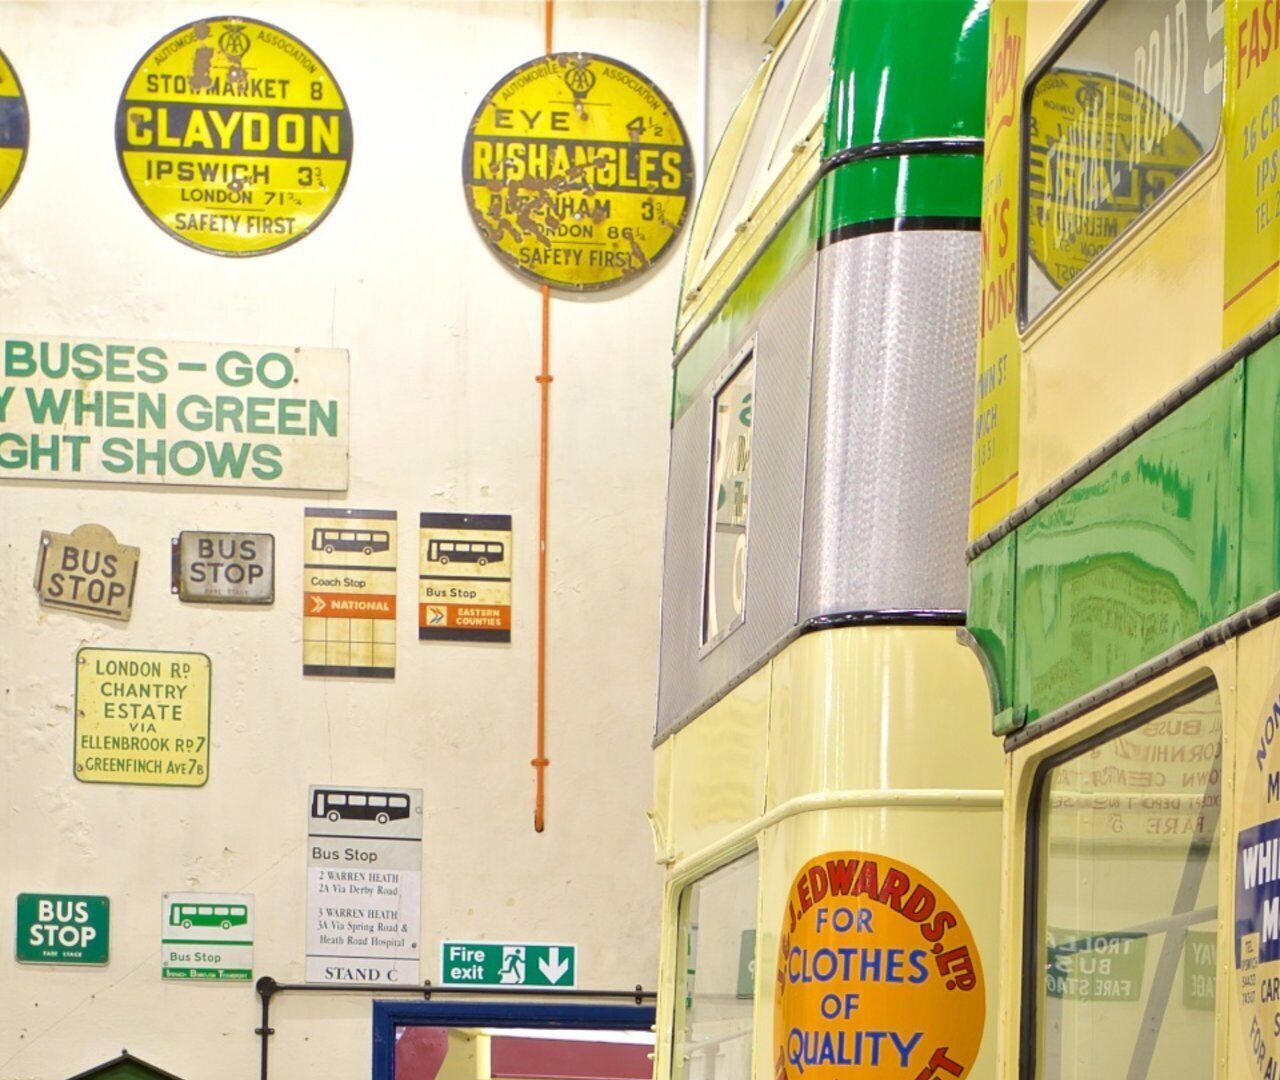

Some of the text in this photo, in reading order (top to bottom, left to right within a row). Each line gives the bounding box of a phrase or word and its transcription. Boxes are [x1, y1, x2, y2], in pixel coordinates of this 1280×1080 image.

[257, 30, 317, 74] ASSOCIATION
[311, 81, 323, 101] 8
[602, 67, 660, 111] ASSOCIATION
[495, 109, 570, 131] EYE
[126, 106, 340, 154] CLAYDON
[147, 160, 269, 184] IPSWICH
[473, 140, 682, 190] RISHANGLES
[181, 188, 252, 205] LONDON
[175, 213, 295, 234] SAFETY FIRST
[519, 247, 583, 266] SAFETY
[4, 339, 295, 390] BUSES GO
[25, 387, 167, 430] WHEN
[175, 394, 339, 438] GREEN
[101, 436, 284, 481] SHOWS
[198, 538, 256, 560] BUS
[61, 545, 118, 578] BUS
[190, 563, 264, 585] STOP
[311, 576, 366, 589] Coach Stop
[47, 573, 125, 607] STOP
[426, 588, 477, 599] Bus Stop
[331, 599, 390, 611] NATIONAL
[457, 607, 500, 617] EASTERN
[455, 617, 502, 626] COUNTIES
[96, 659, 161, 677] LONDON
[100, 683, 188, 699] CHANTRY
[104, 702, 182, 721] ESTATE
[129, 722, 157, 733] VIA
[81, 735, 169, 751] ELLENBROOK
[85, 756, 162, 774] GREENFINCH
[312, 847, 378, 863] Bus Stop
[327, 871, 366, 881] WARREN
[369, 873, 398, 883] HEATH
[349, 884, 373, 896] Derby
[377, 886, 398, 895] Road
[38, 900, 89, 923] BUS
[326, 908, 398, 920] WARREN HEATH
[816, 908, 874, 933] FOR
[30, 924, 96, 948] STOP
[347, 922, 374, 933] Spring
[378, 923, 398, 932] Road
[320, 935, 404, 948] Heath Road Hospital
[170, 952, 221, 963] Bus Stop
[450, 947, 485, 963] Fire
[325, 967, 398, 981] STAND C
[451, 965, 484, 980] exit
[788, 947, 929, 984] CLOTHES
[1260, 975, 1280, 1002] CAR
[820, 994, 860, 1019] OF
[787, 1028, 924, 1074] QUALITY
[1249, 1015, 1267, 1073] FOR
